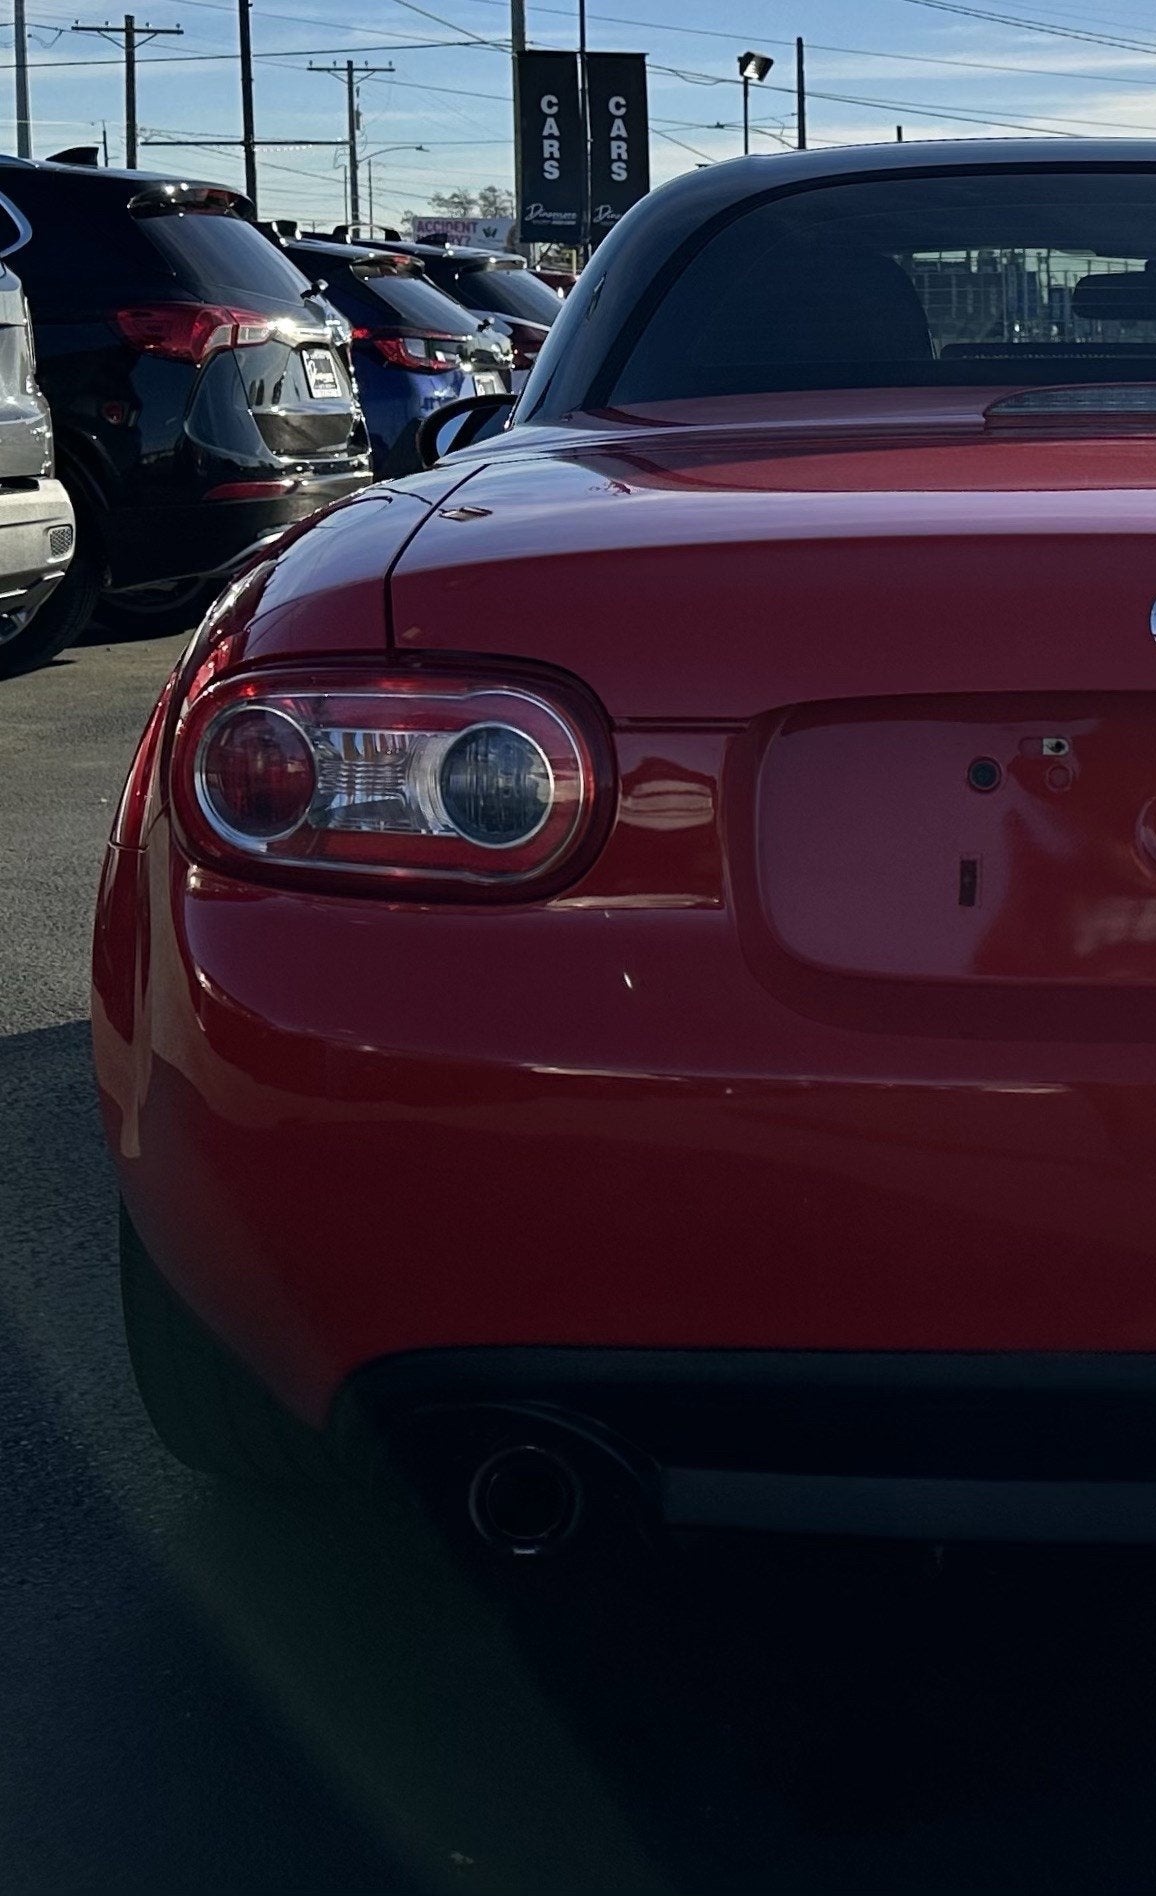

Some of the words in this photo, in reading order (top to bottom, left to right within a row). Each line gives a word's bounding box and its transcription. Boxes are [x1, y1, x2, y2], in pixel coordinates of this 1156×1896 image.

[540, 95, 560, 180] CARS
[608, 96, 628, 181] CARS
[417, 220, 477, 233] ACCIDENT
